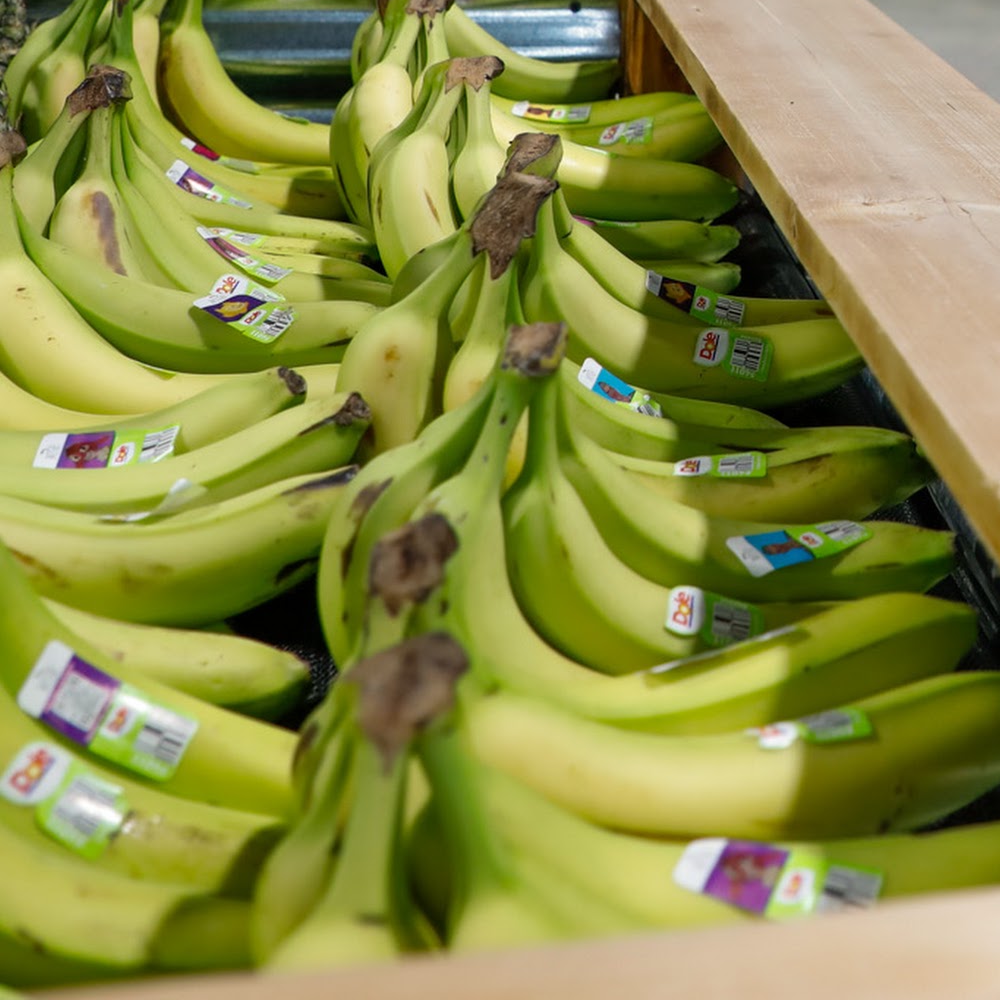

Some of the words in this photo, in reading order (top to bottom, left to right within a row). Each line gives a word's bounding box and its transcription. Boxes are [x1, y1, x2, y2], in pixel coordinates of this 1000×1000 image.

[699, 331, 717, 360] Dole
[671, 591, 692, 626] Dole
[9, 749, 50, 796] Dole
